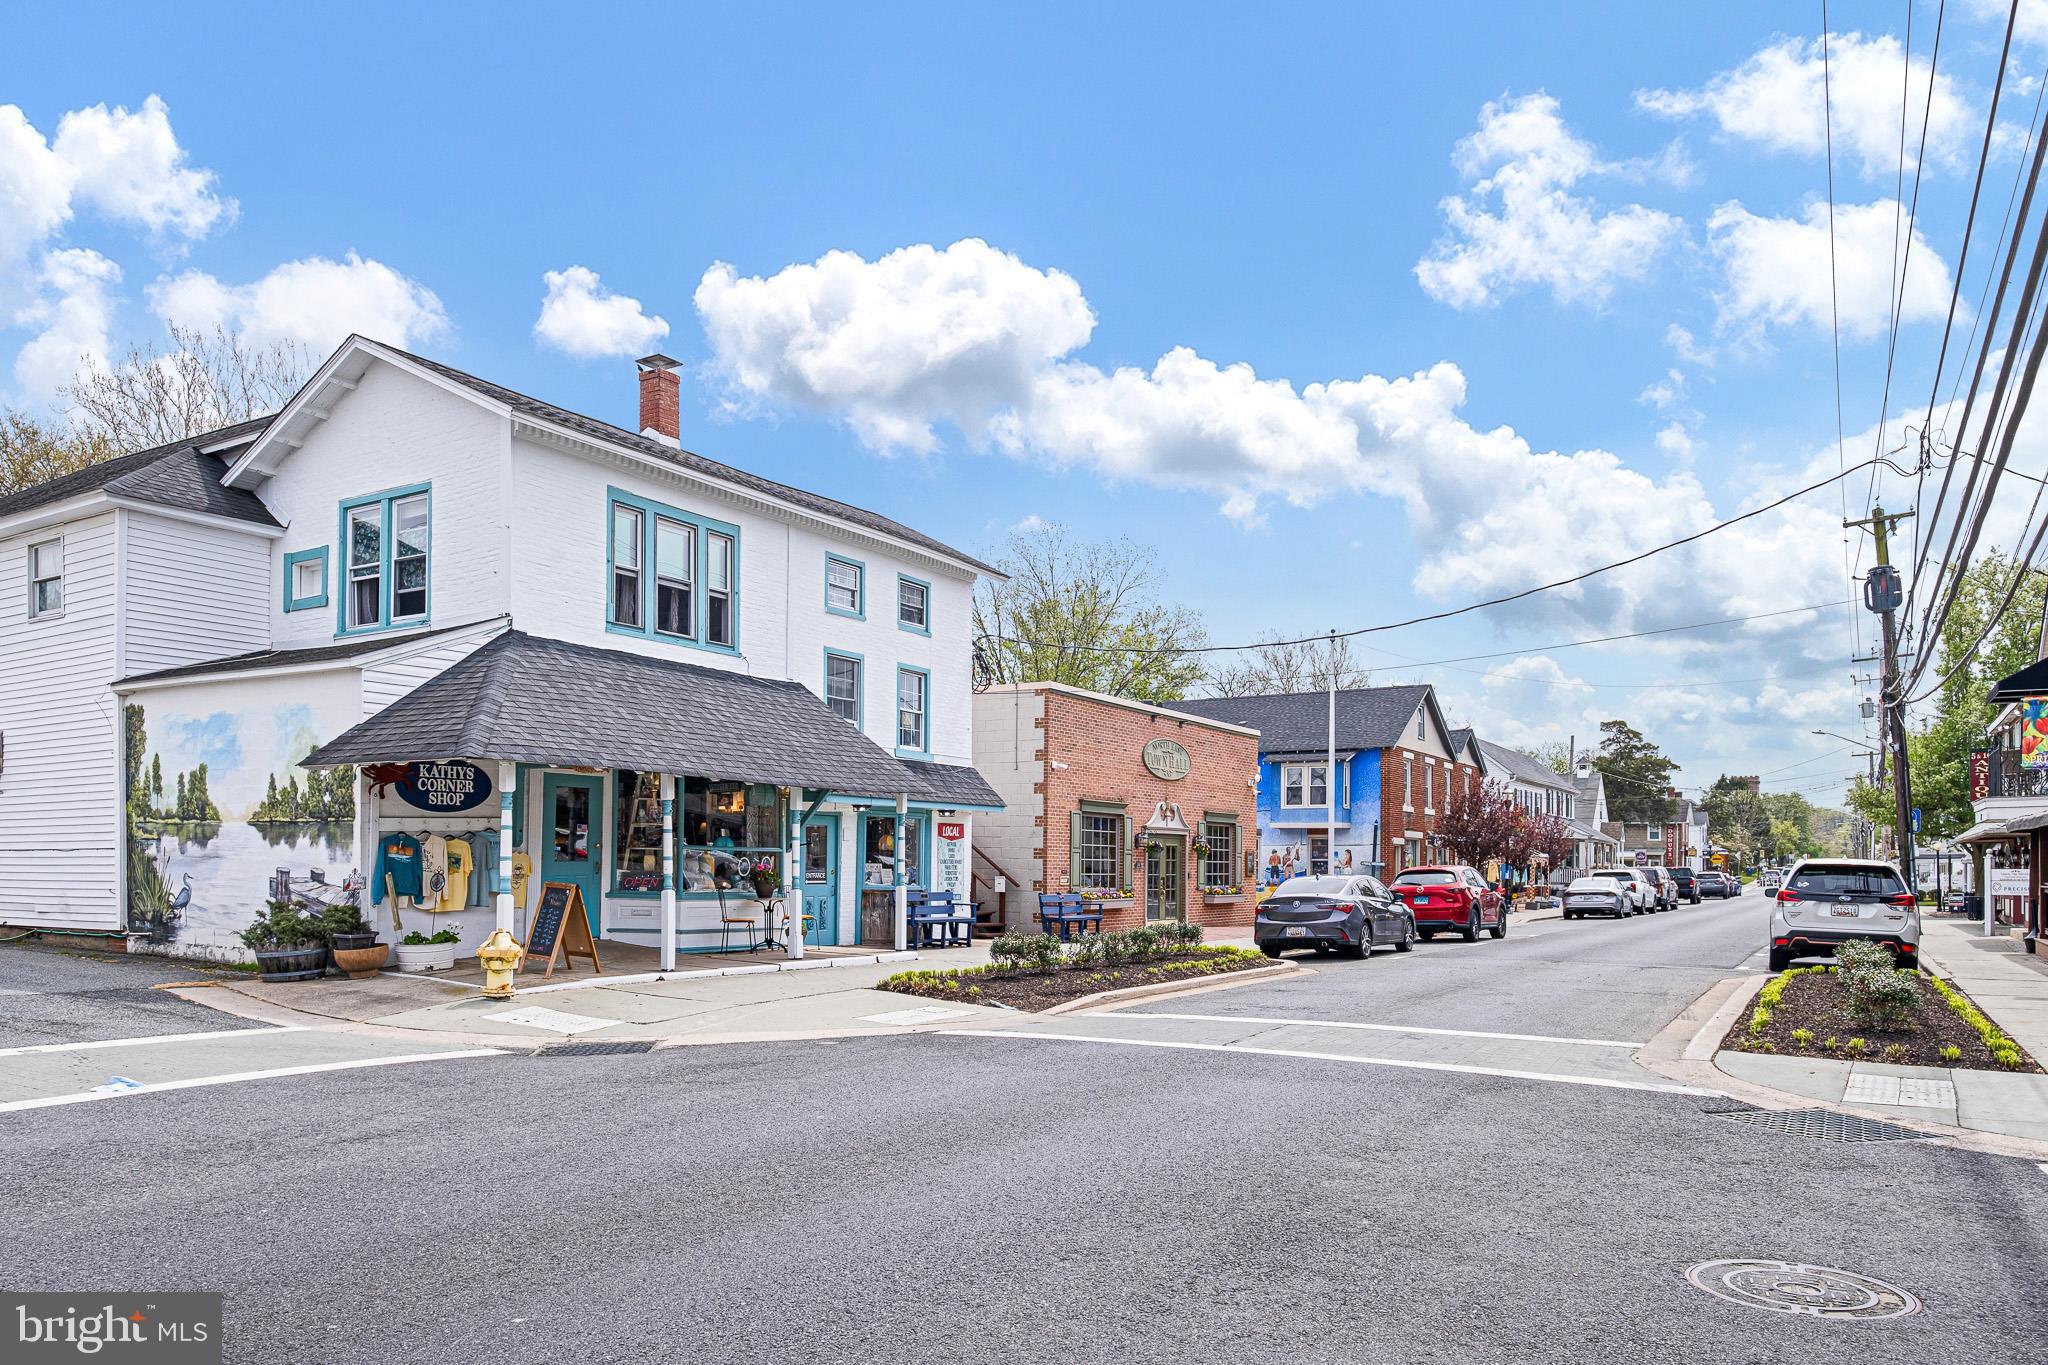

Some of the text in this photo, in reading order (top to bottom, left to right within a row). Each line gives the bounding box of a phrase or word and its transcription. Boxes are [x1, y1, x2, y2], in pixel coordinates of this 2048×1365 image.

[419, 764, 474, 779] KATHYS
[418, 778, 474, 793] CORNER
[428, 792, 465, 806] SHOP
[942, 826, 960, 837] LOCAL
[624, 877, 659, 888] OPEN
